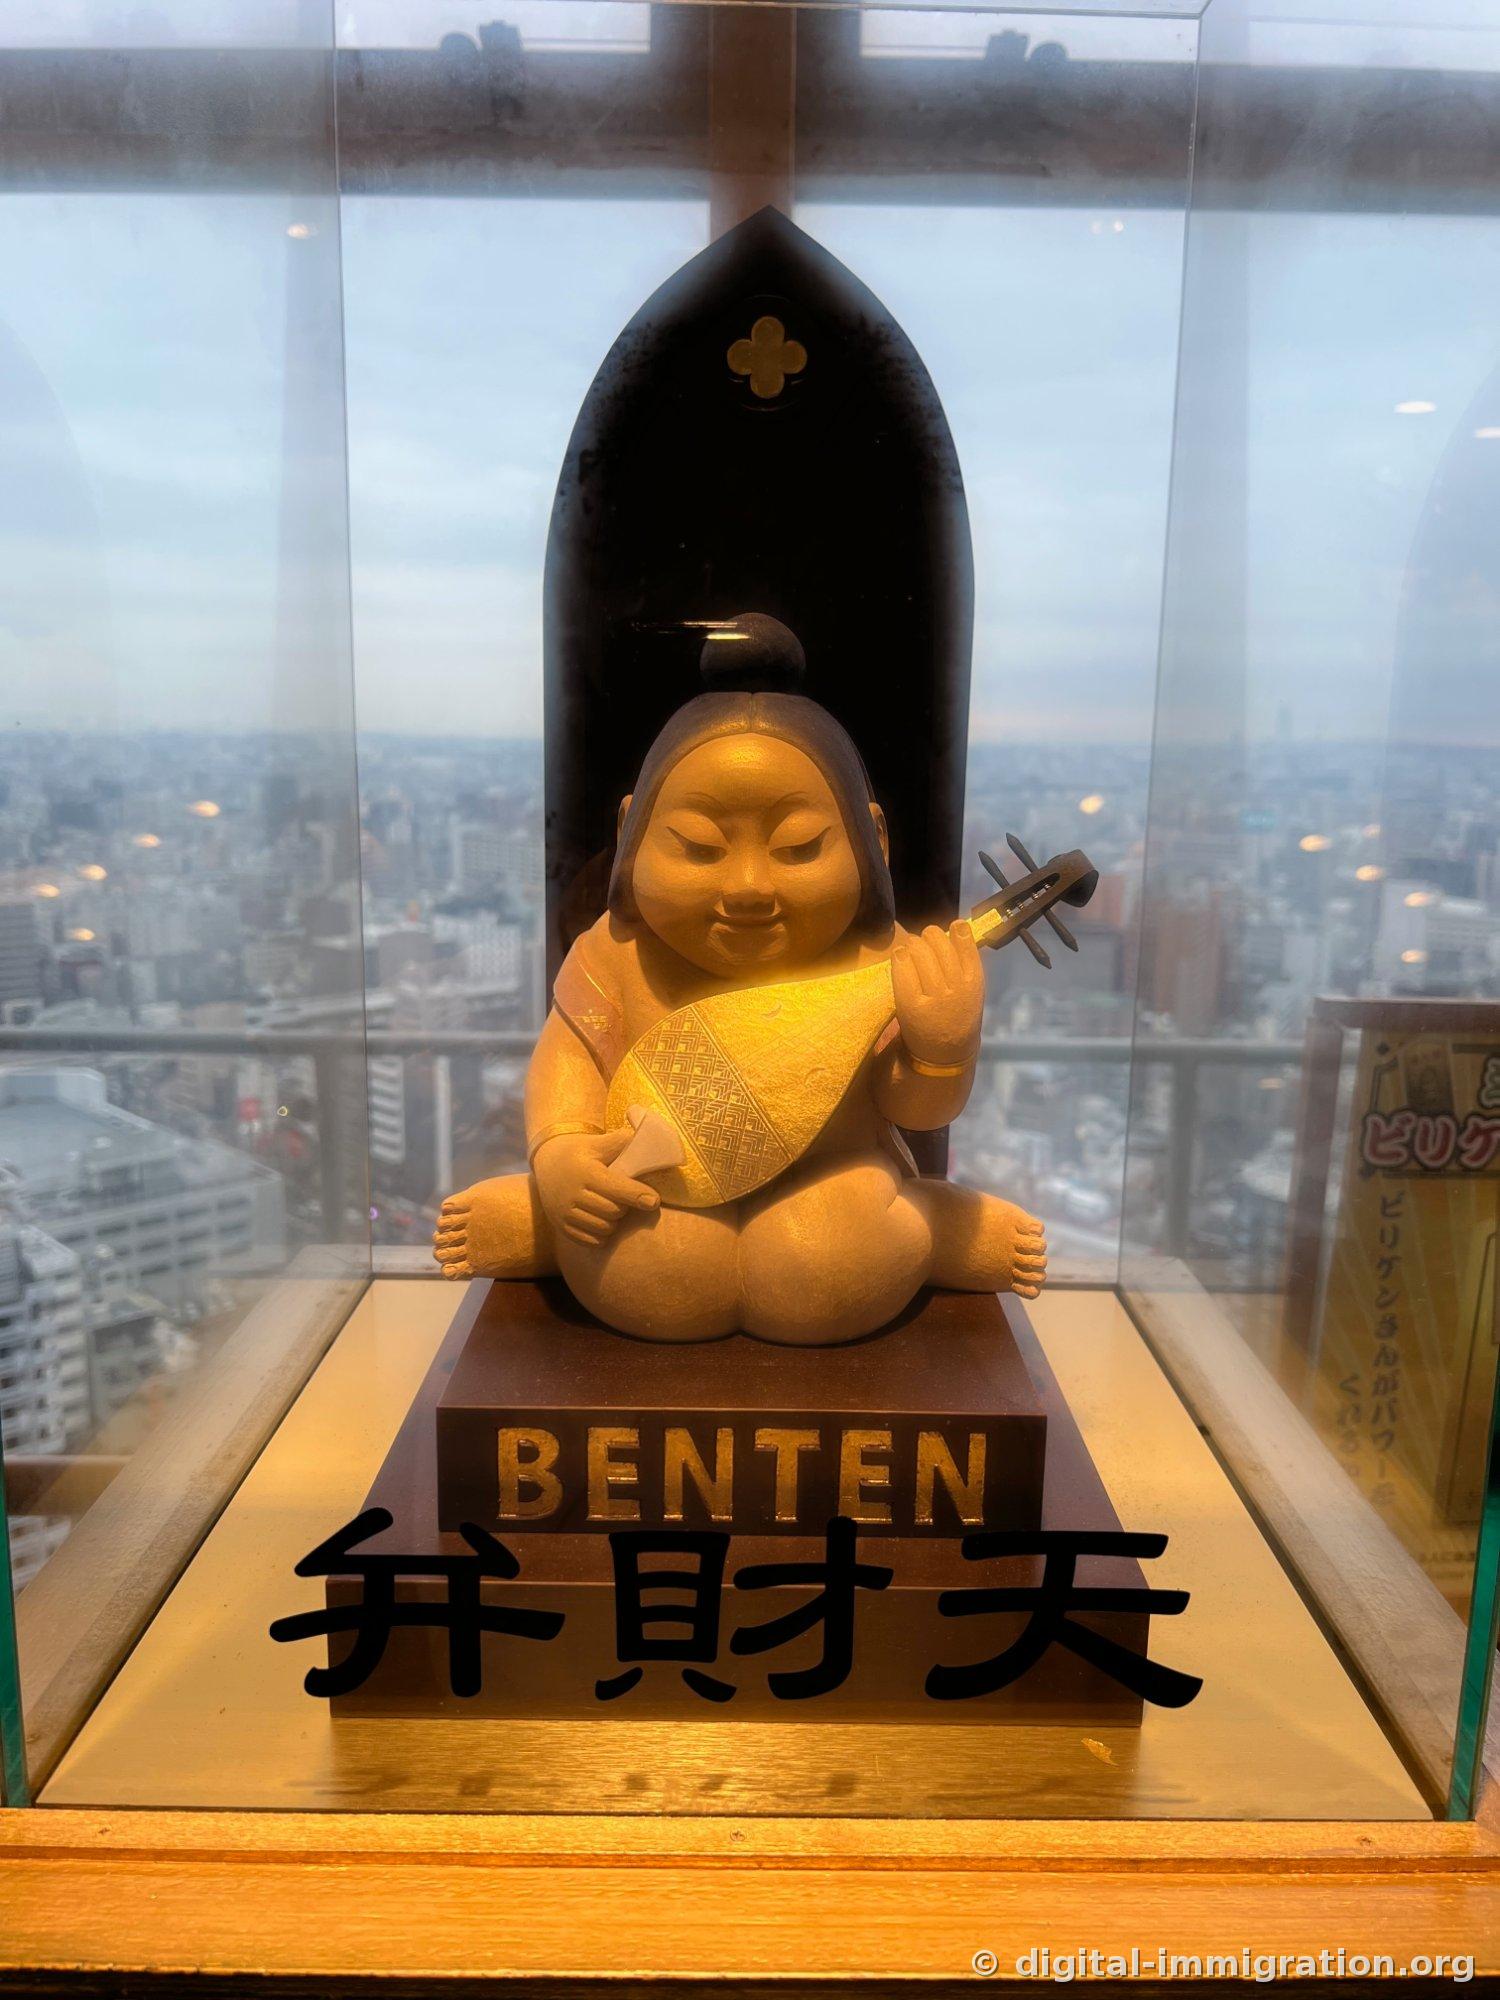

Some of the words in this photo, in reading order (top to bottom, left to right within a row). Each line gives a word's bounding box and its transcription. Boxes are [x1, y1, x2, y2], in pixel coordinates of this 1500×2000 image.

[496, 1427, 986, 1526] BENTEN
[269, 1507, 1204, 1708] 弁財天
